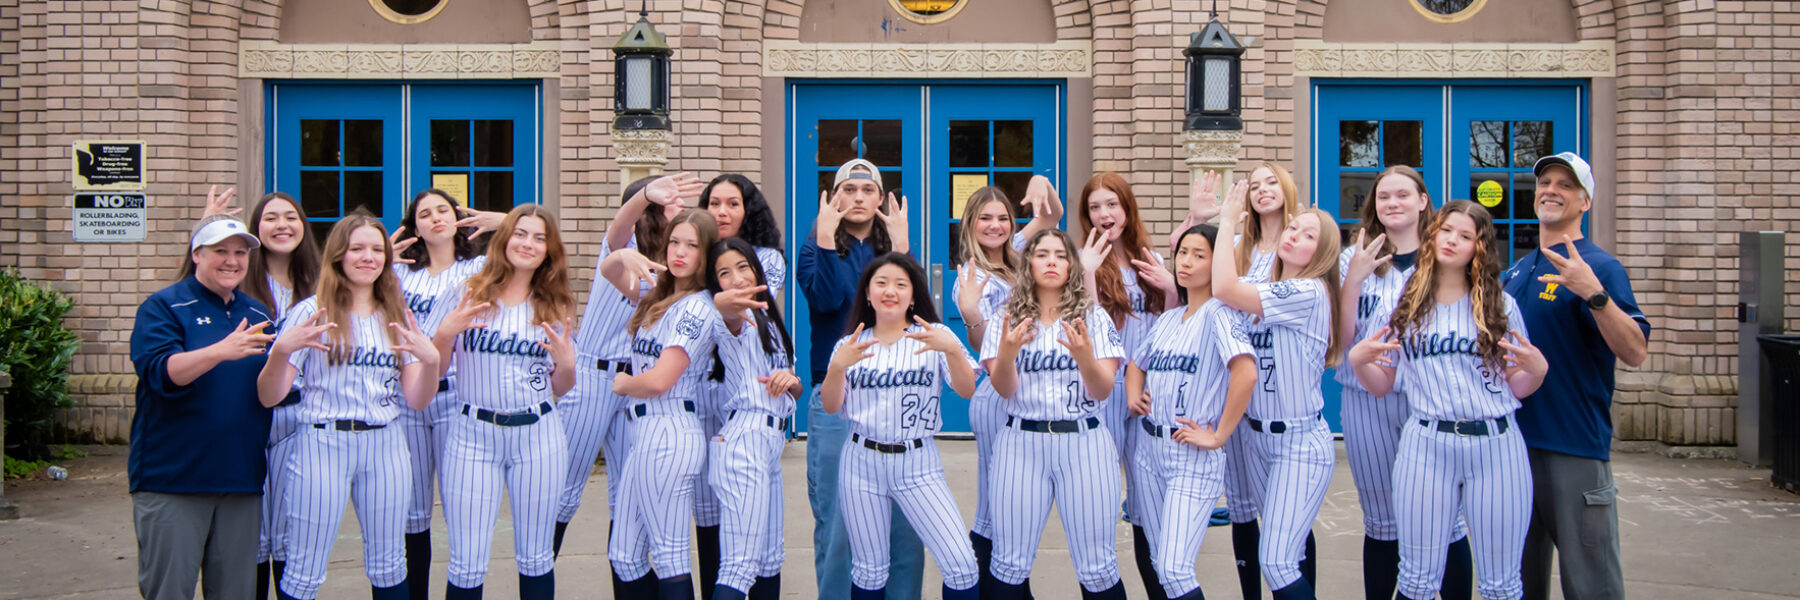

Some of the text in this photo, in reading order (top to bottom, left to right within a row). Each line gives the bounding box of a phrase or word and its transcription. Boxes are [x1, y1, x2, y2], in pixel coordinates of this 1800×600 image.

[94, 195, 124, 208] NO
[529, 362, 547, 391] 3
[901, 394, 939, 430] 24
